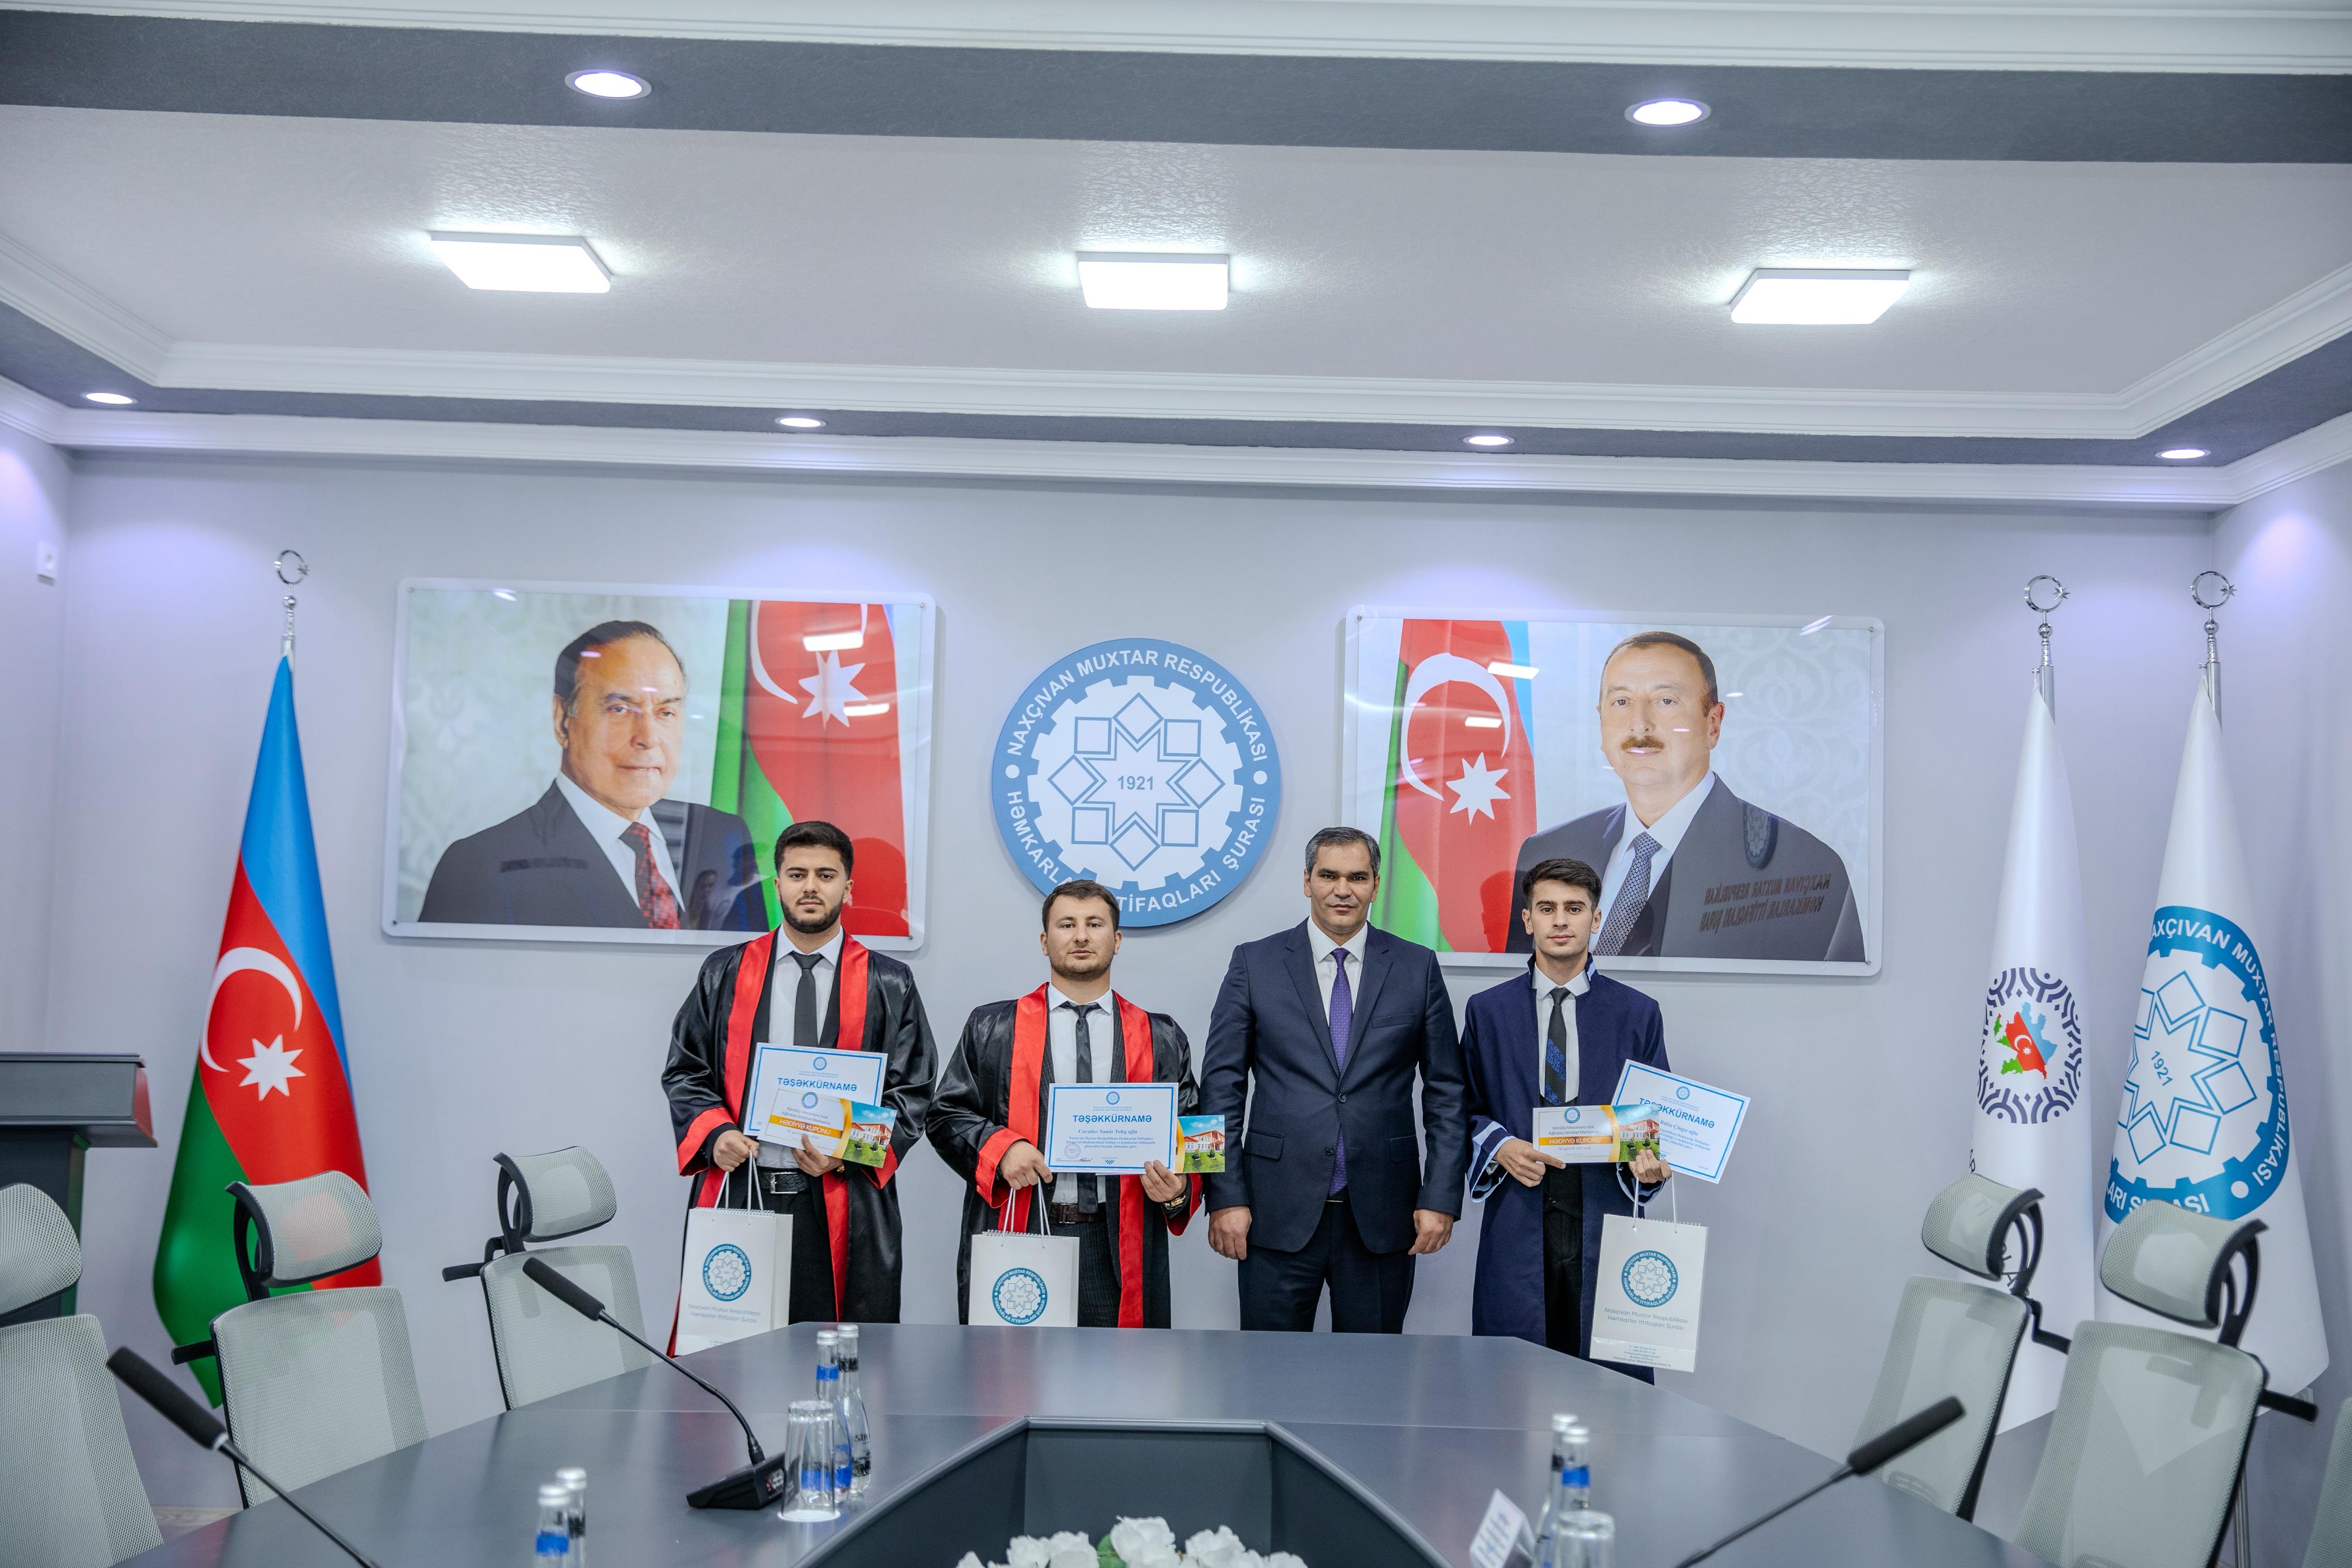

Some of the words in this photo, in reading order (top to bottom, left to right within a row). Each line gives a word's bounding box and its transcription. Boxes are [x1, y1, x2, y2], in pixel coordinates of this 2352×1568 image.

[1007, 670, 1075, 756] NAXÇIVAN
[1076, 650, 1158, 677] MUXTAR
[1164, 653, 1268, 761] RESPUBLİKASI
[1117, 776, 1154, 790] 1921
[1116, 869, 1222, 912] TİFAQLARI
[1222, 796, 1265, 870] ŞURASI
[2150, 918, 2230, 949] AXÇIVAN
[2231, 942, 2273, 1026] MUXTAR
[2252, 1032, 2286, 1186] RESPUBLİKASI
[2150, 1050, 2173, 1087] 1921
[778, 1077, 857, 1091] TƏŞƏKKÜRNAMƏ
[1073, 1114, 1152, 1124] TƏŞƏKKÜRNAMƏ
[806, 1125, 831, 1135] KUPONU
[1605, 1307, 1631, 1316] Naxçıvan
[1653, 1314, 1688, 1323] Respublikası
[1608, 1315, 1637, 1324] Həmkarlar
